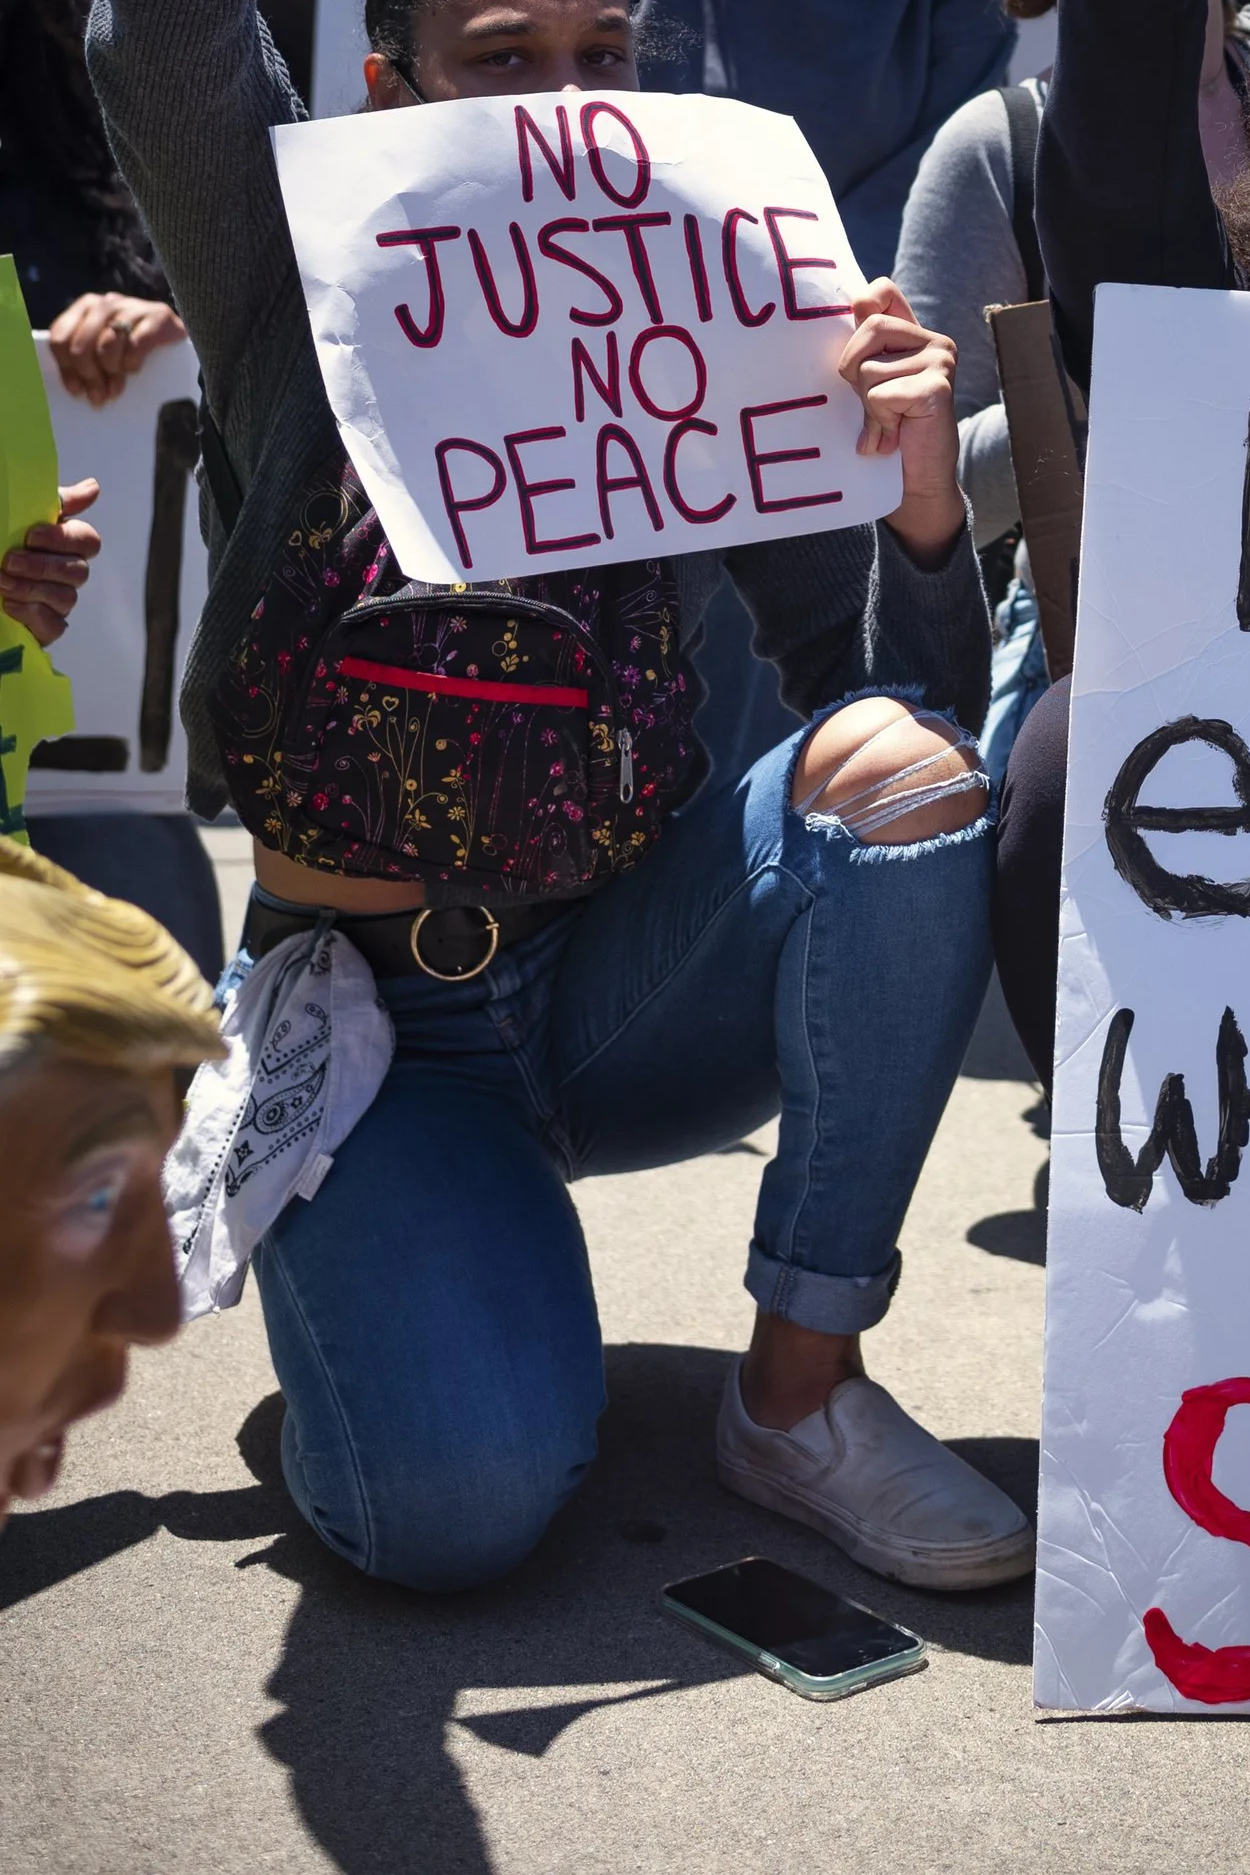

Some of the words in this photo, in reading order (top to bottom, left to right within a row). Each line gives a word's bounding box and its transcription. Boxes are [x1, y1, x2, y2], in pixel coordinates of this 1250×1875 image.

[514, 101, 651, 209] NO
[375, 206, 855, 349] JUSTICE
[570, 325, 708, 424] NO
[434, 394, 844, 569] PEACE
